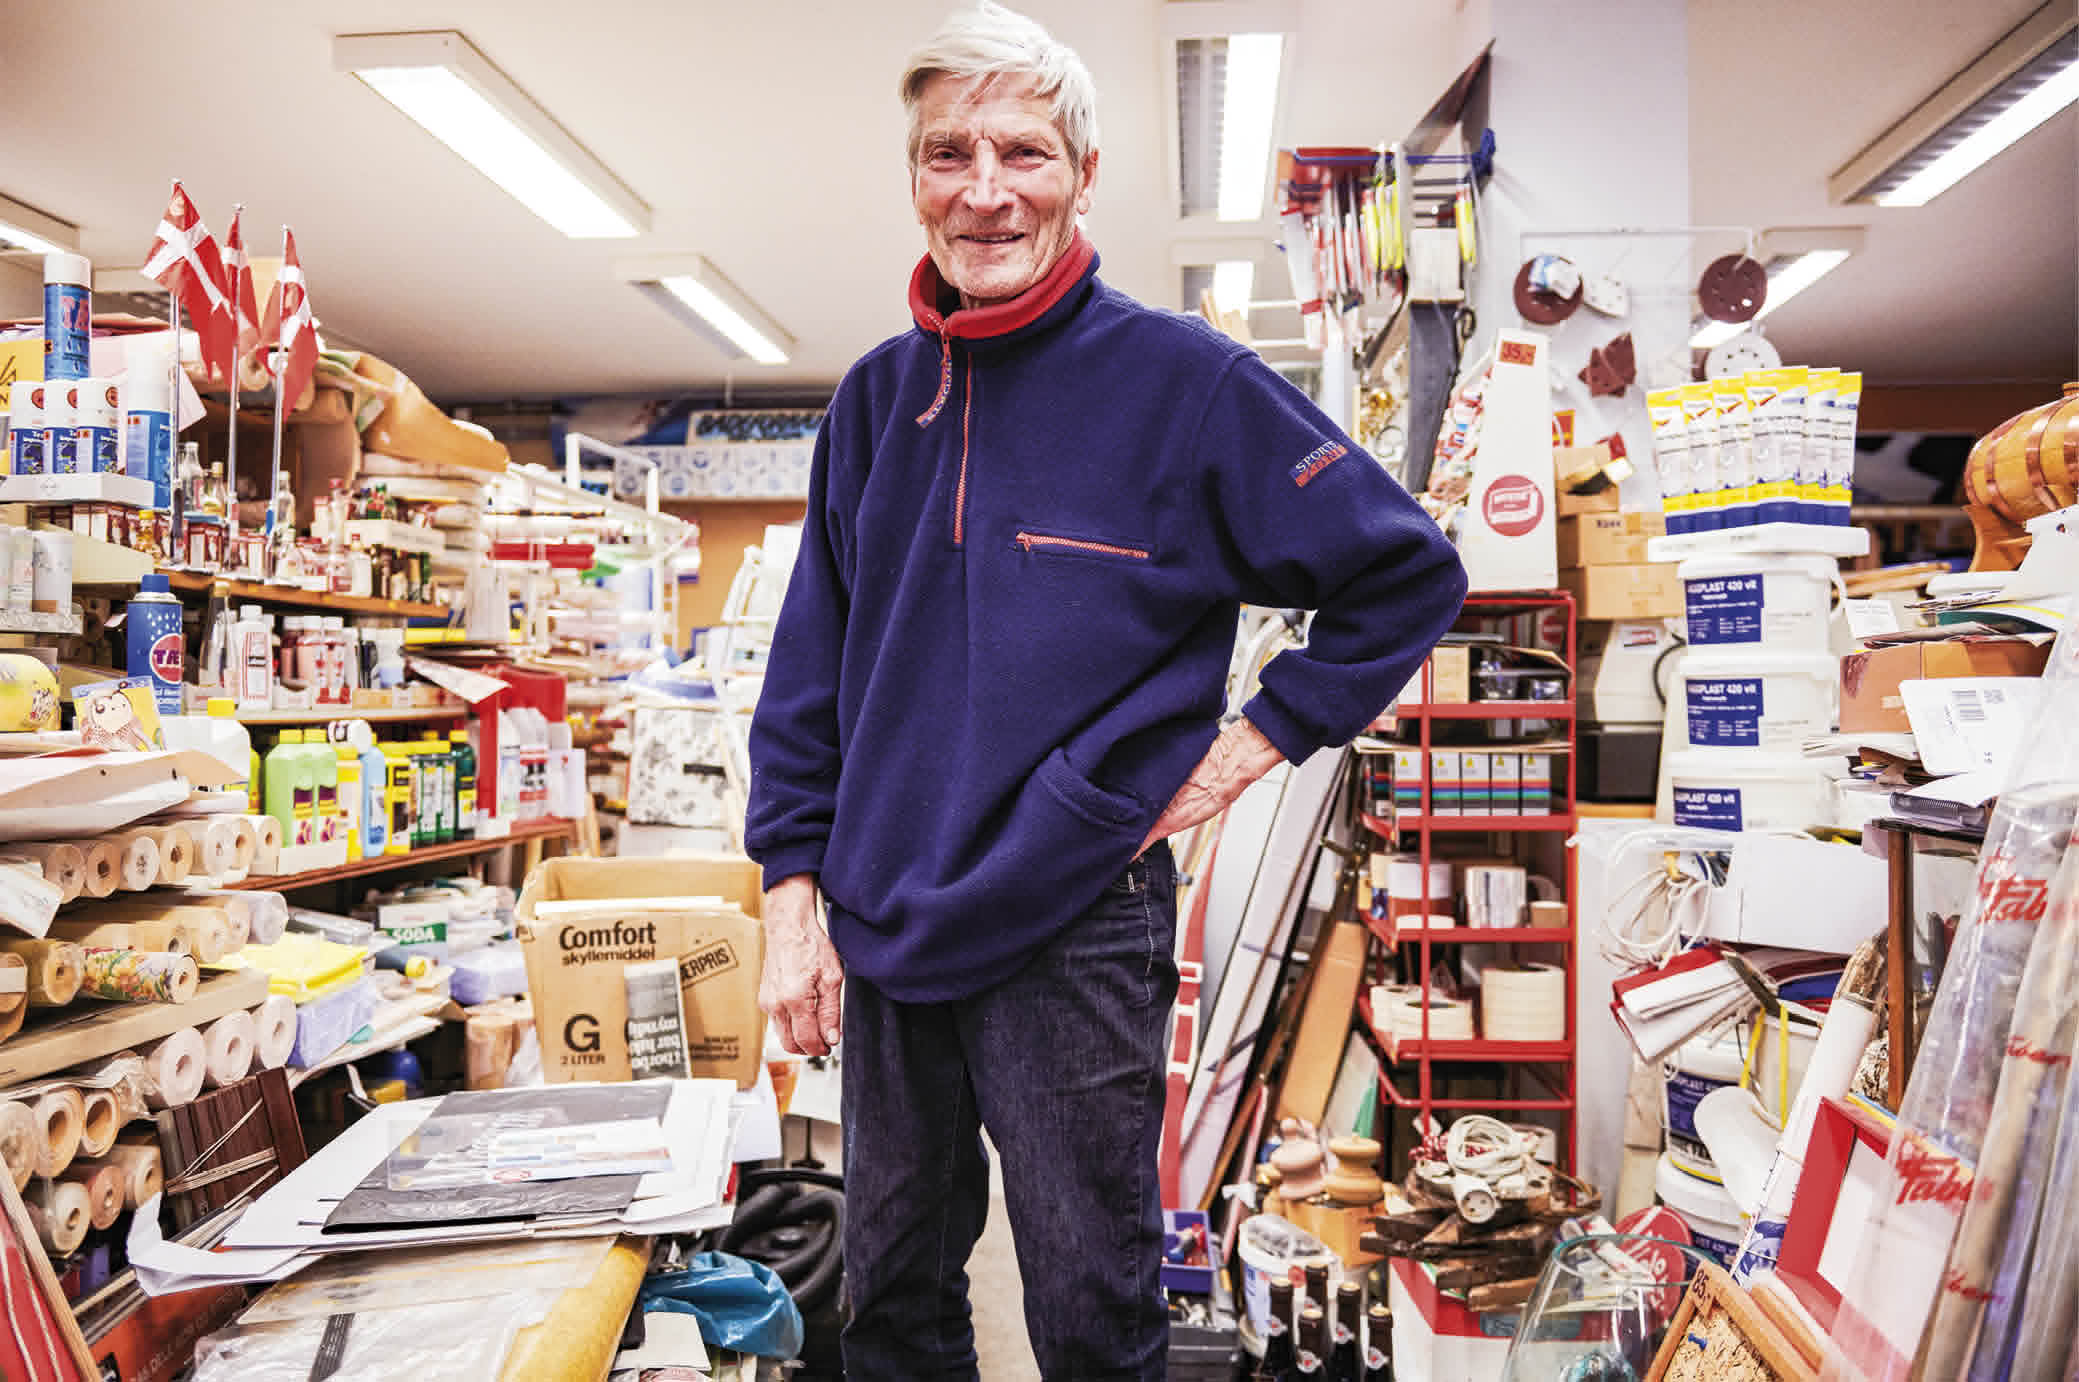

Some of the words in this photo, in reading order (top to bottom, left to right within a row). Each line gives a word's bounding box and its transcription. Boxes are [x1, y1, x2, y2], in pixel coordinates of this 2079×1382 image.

[391, 926, 435, 944] SODA
[560, 920, 657, 951] Comfort
[562, 946, 656, 966] skyllemiddel
[564, 1013, 601, 1052] G
[560, 1055, 569, 1065] 2
[570, 1054, 606, 1065] LITER
